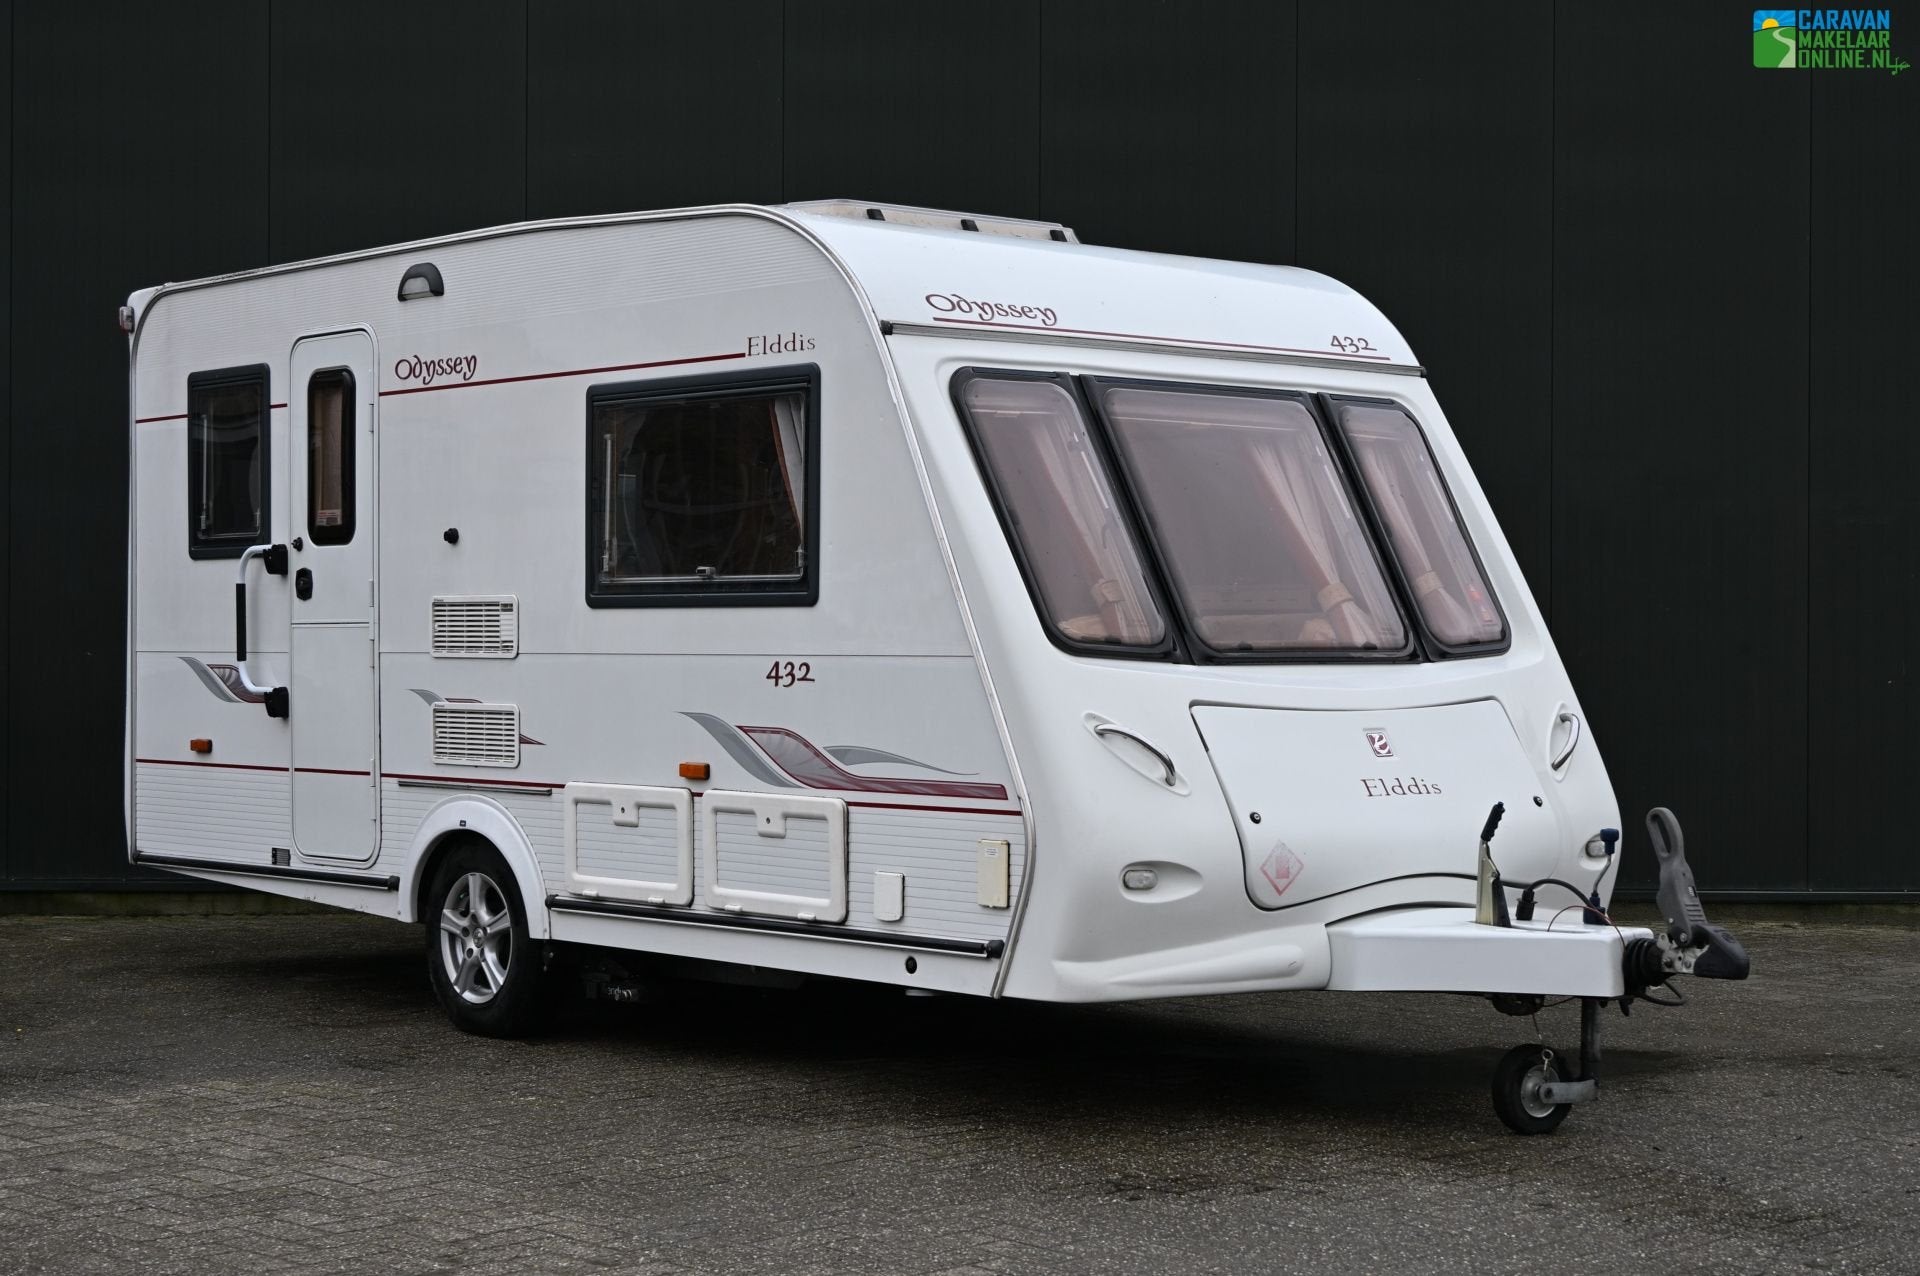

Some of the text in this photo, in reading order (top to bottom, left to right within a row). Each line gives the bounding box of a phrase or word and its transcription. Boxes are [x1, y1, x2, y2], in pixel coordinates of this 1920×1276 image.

[925, 293, 1058, 327] Odyssey
[746, 331, 816, 357] Elddis
[1330, 335, 1378, 354] 432
[394, 354, 478, 386] Odyssey
[765, 660, 816, 688] 432
[1360, 776, 1442, 797] Elddis
